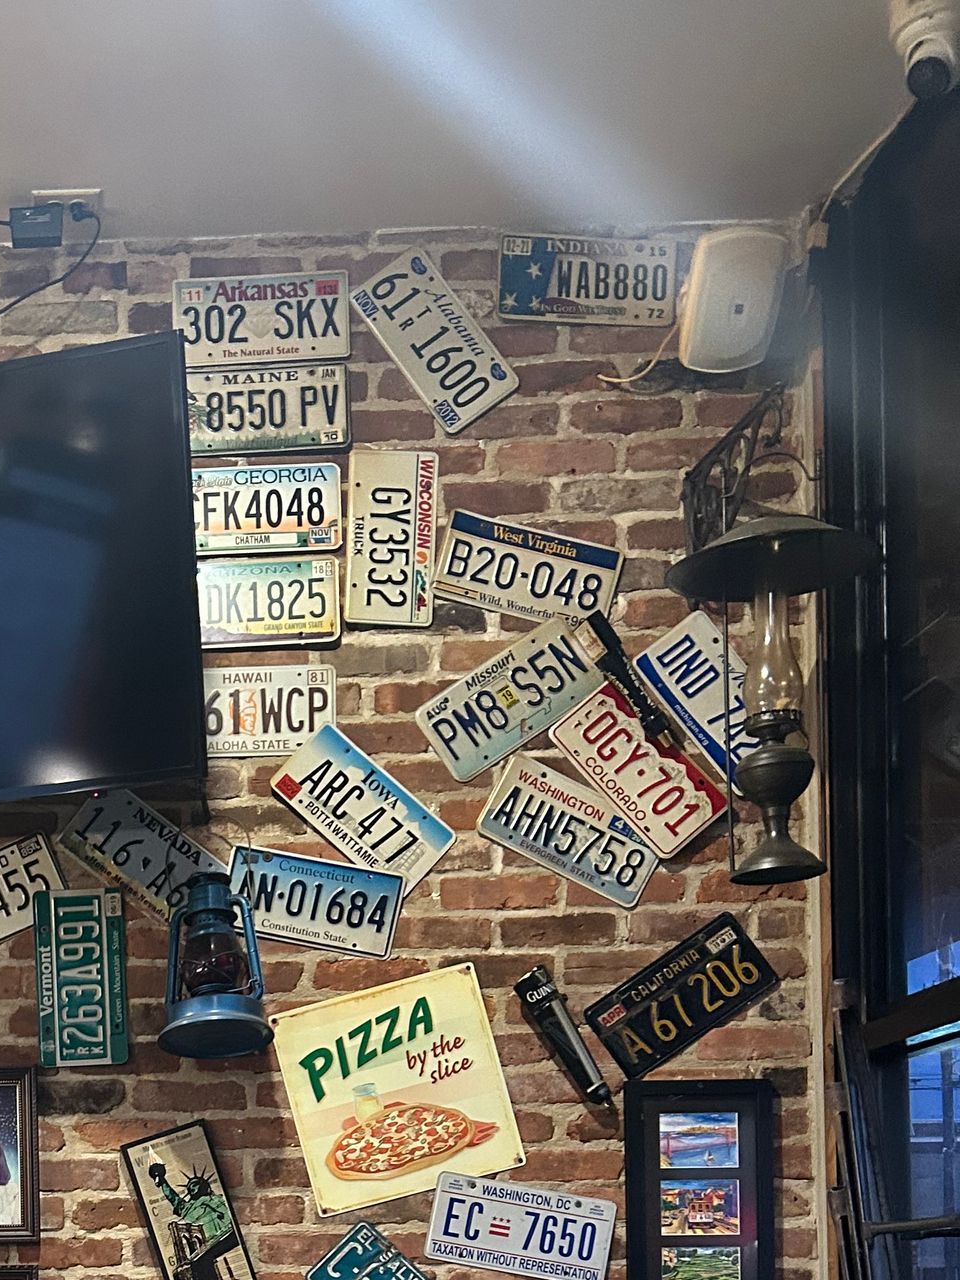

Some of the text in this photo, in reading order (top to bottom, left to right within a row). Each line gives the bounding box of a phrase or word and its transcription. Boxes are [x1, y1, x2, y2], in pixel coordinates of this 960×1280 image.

[212, 280, 310, 304] Arkansas
[557, 259, 669, 302] WAB880
[182, 297, 341, 346] 302 SKX
[371, 272, 490, 409] 61 1600
[240, 346, 300, 358] Natural State
[222, 370, 299, 386] MAINE
[206, 384, 339, 433] 8550 PV
[435, 399, 461, 427] 2012
[234, 467, 328, 486] GEORGIA
[415, 458, 435, 550] WISCONSIN
[235, 534, 271, 545] CHATHAM
[351, 516, 365, 557] TRUCK
[365, 486, 413, 609] GY3532
[492, 525, 577, 559] West Virginia
[445, 537, 603, 612] B20-048
[205, 577, 327, 625] DK1825
[478, 592, 504, 609] Wild,
[222, 671, 326, 685] HAWAII 81
[465, 650, 517, 691] Missouri
[655, 633, 721, 700] DND
[259, 686, 329, 735] WCP
[431, 689, 511, 761] PM8
[510, 634, 589, 708] S5N
[207, 739, 291, 752] ALOHA STATE
[673, 704, 710, 747] michigan.org
[297, 758, 420, 865] ARC 477
[517, 768, 606, 823] WASHINGTON
[585, 756, 647, 822] COLORADO
[132, 807, 202, 866] NEVADA
[304, 800, 380, 869] POTTAWATTAMIE
[490, 784, 647, 888] AHN5758
[279, 859, 356, 885] Connecticut
[261, 918, 348, 945] Constitution State
[39, 944, 54, 1018] Vermont
[58, 898, 104, 1044] 263A991
[631, 949, 702, 1002] CALIFORNIA
[298, 996, 435, 1104] PIZZA
[405, 1034, 466, 1078] by the
[430, 1054, 474, 1085] slice
[481, 1183, 554, 1211] WASHINGTON,
[556, 1198, 572, 1211] DC
[355, 1228, 379, 1252] EL
[442, 1196, 598, 1262] EC 7650
[431, 1241, 475, 1260] TAXATION
[475, 1250, 519, 1268] WITHOUT
